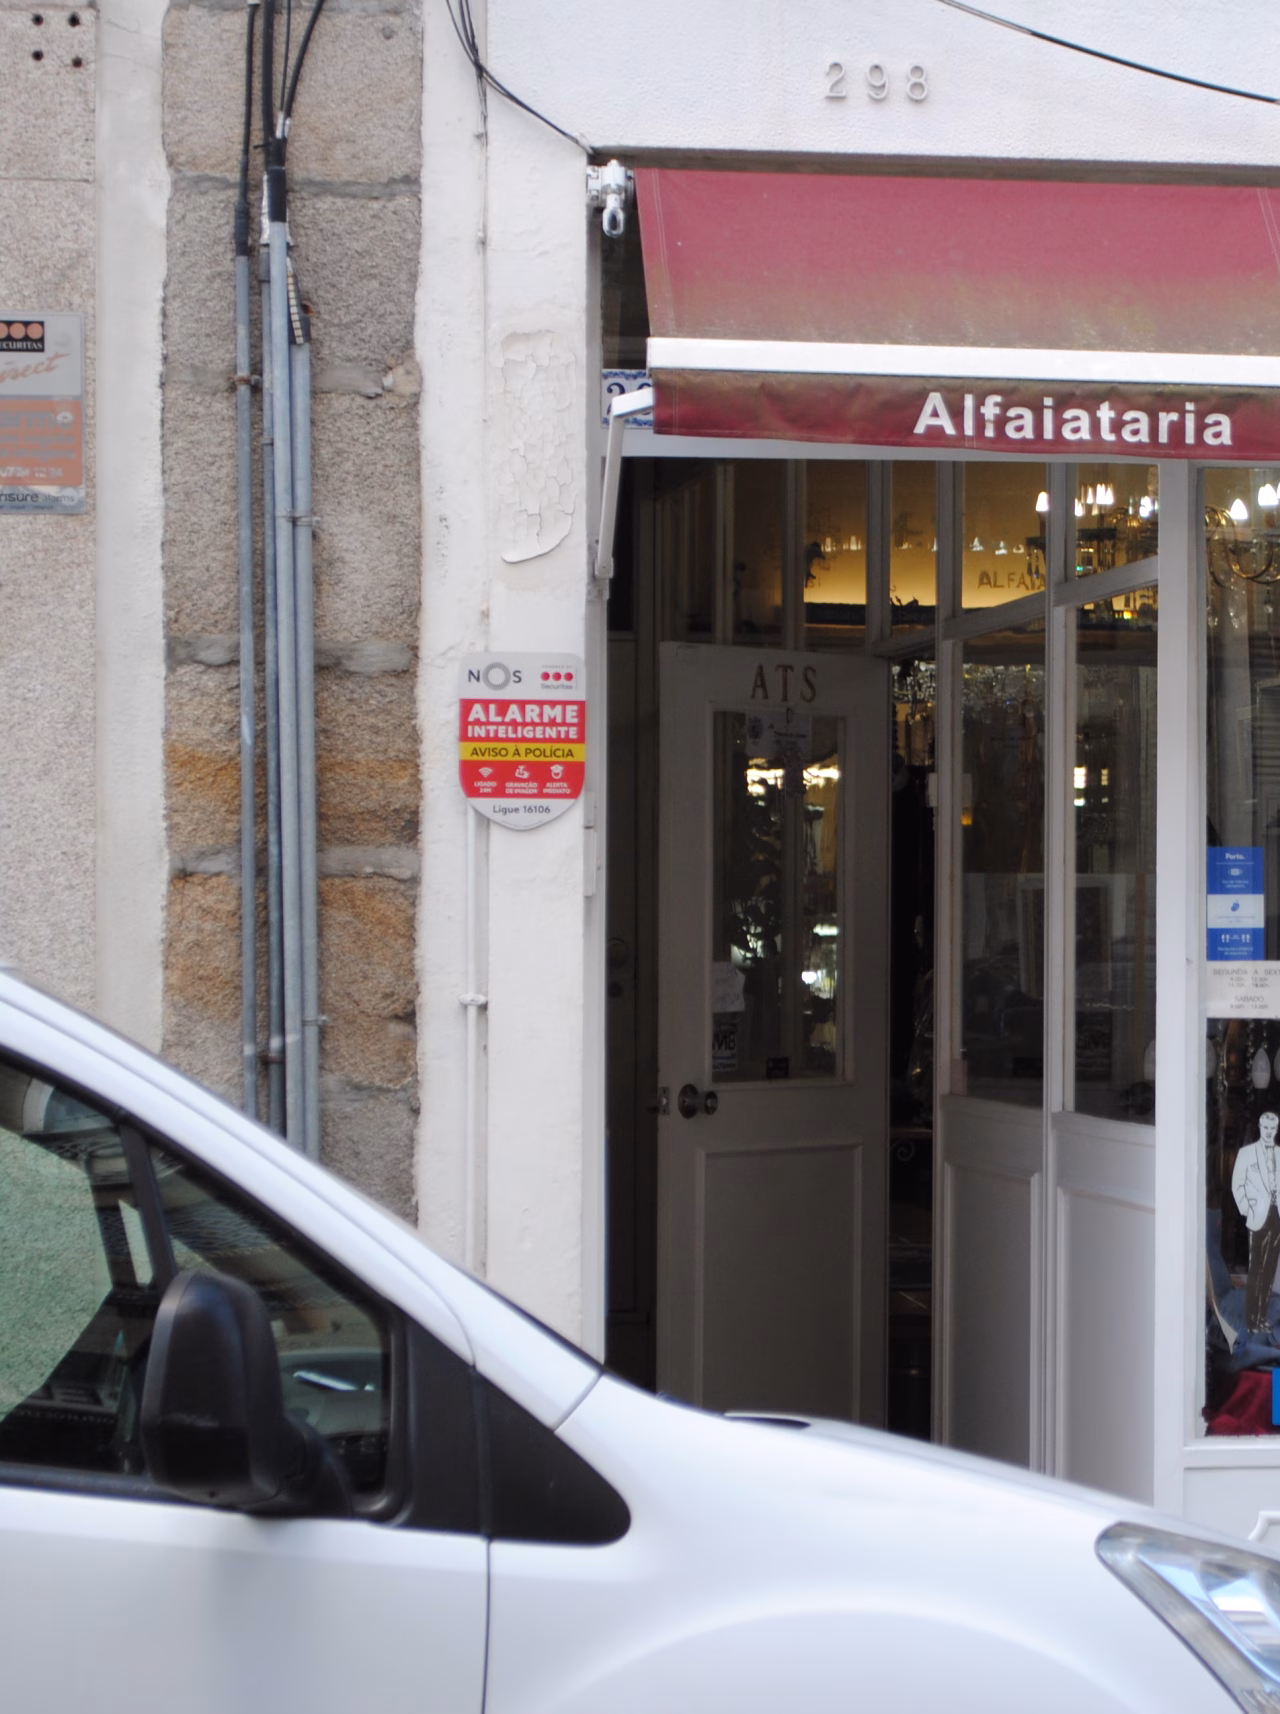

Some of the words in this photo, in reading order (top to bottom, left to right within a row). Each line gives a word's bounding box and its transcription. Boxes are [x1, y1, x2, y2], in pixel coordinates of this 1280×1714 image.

[824, 62, 927, 101] 298
[913, 391, 1232, 446] Alfaiataria
[468, 662, 522, 691] NOS
[467, 703, 579, 723] ALARME
[467, 725, 578, 739] INTELIGENTE
[470, 747, 508, 758] AVISO
[512, 745, 521, 758] À
[524, 746, 574, 758] POLÍCIA
[493, 804, 520, 815] Ligue
[523, 805, 551, 814] 16106
